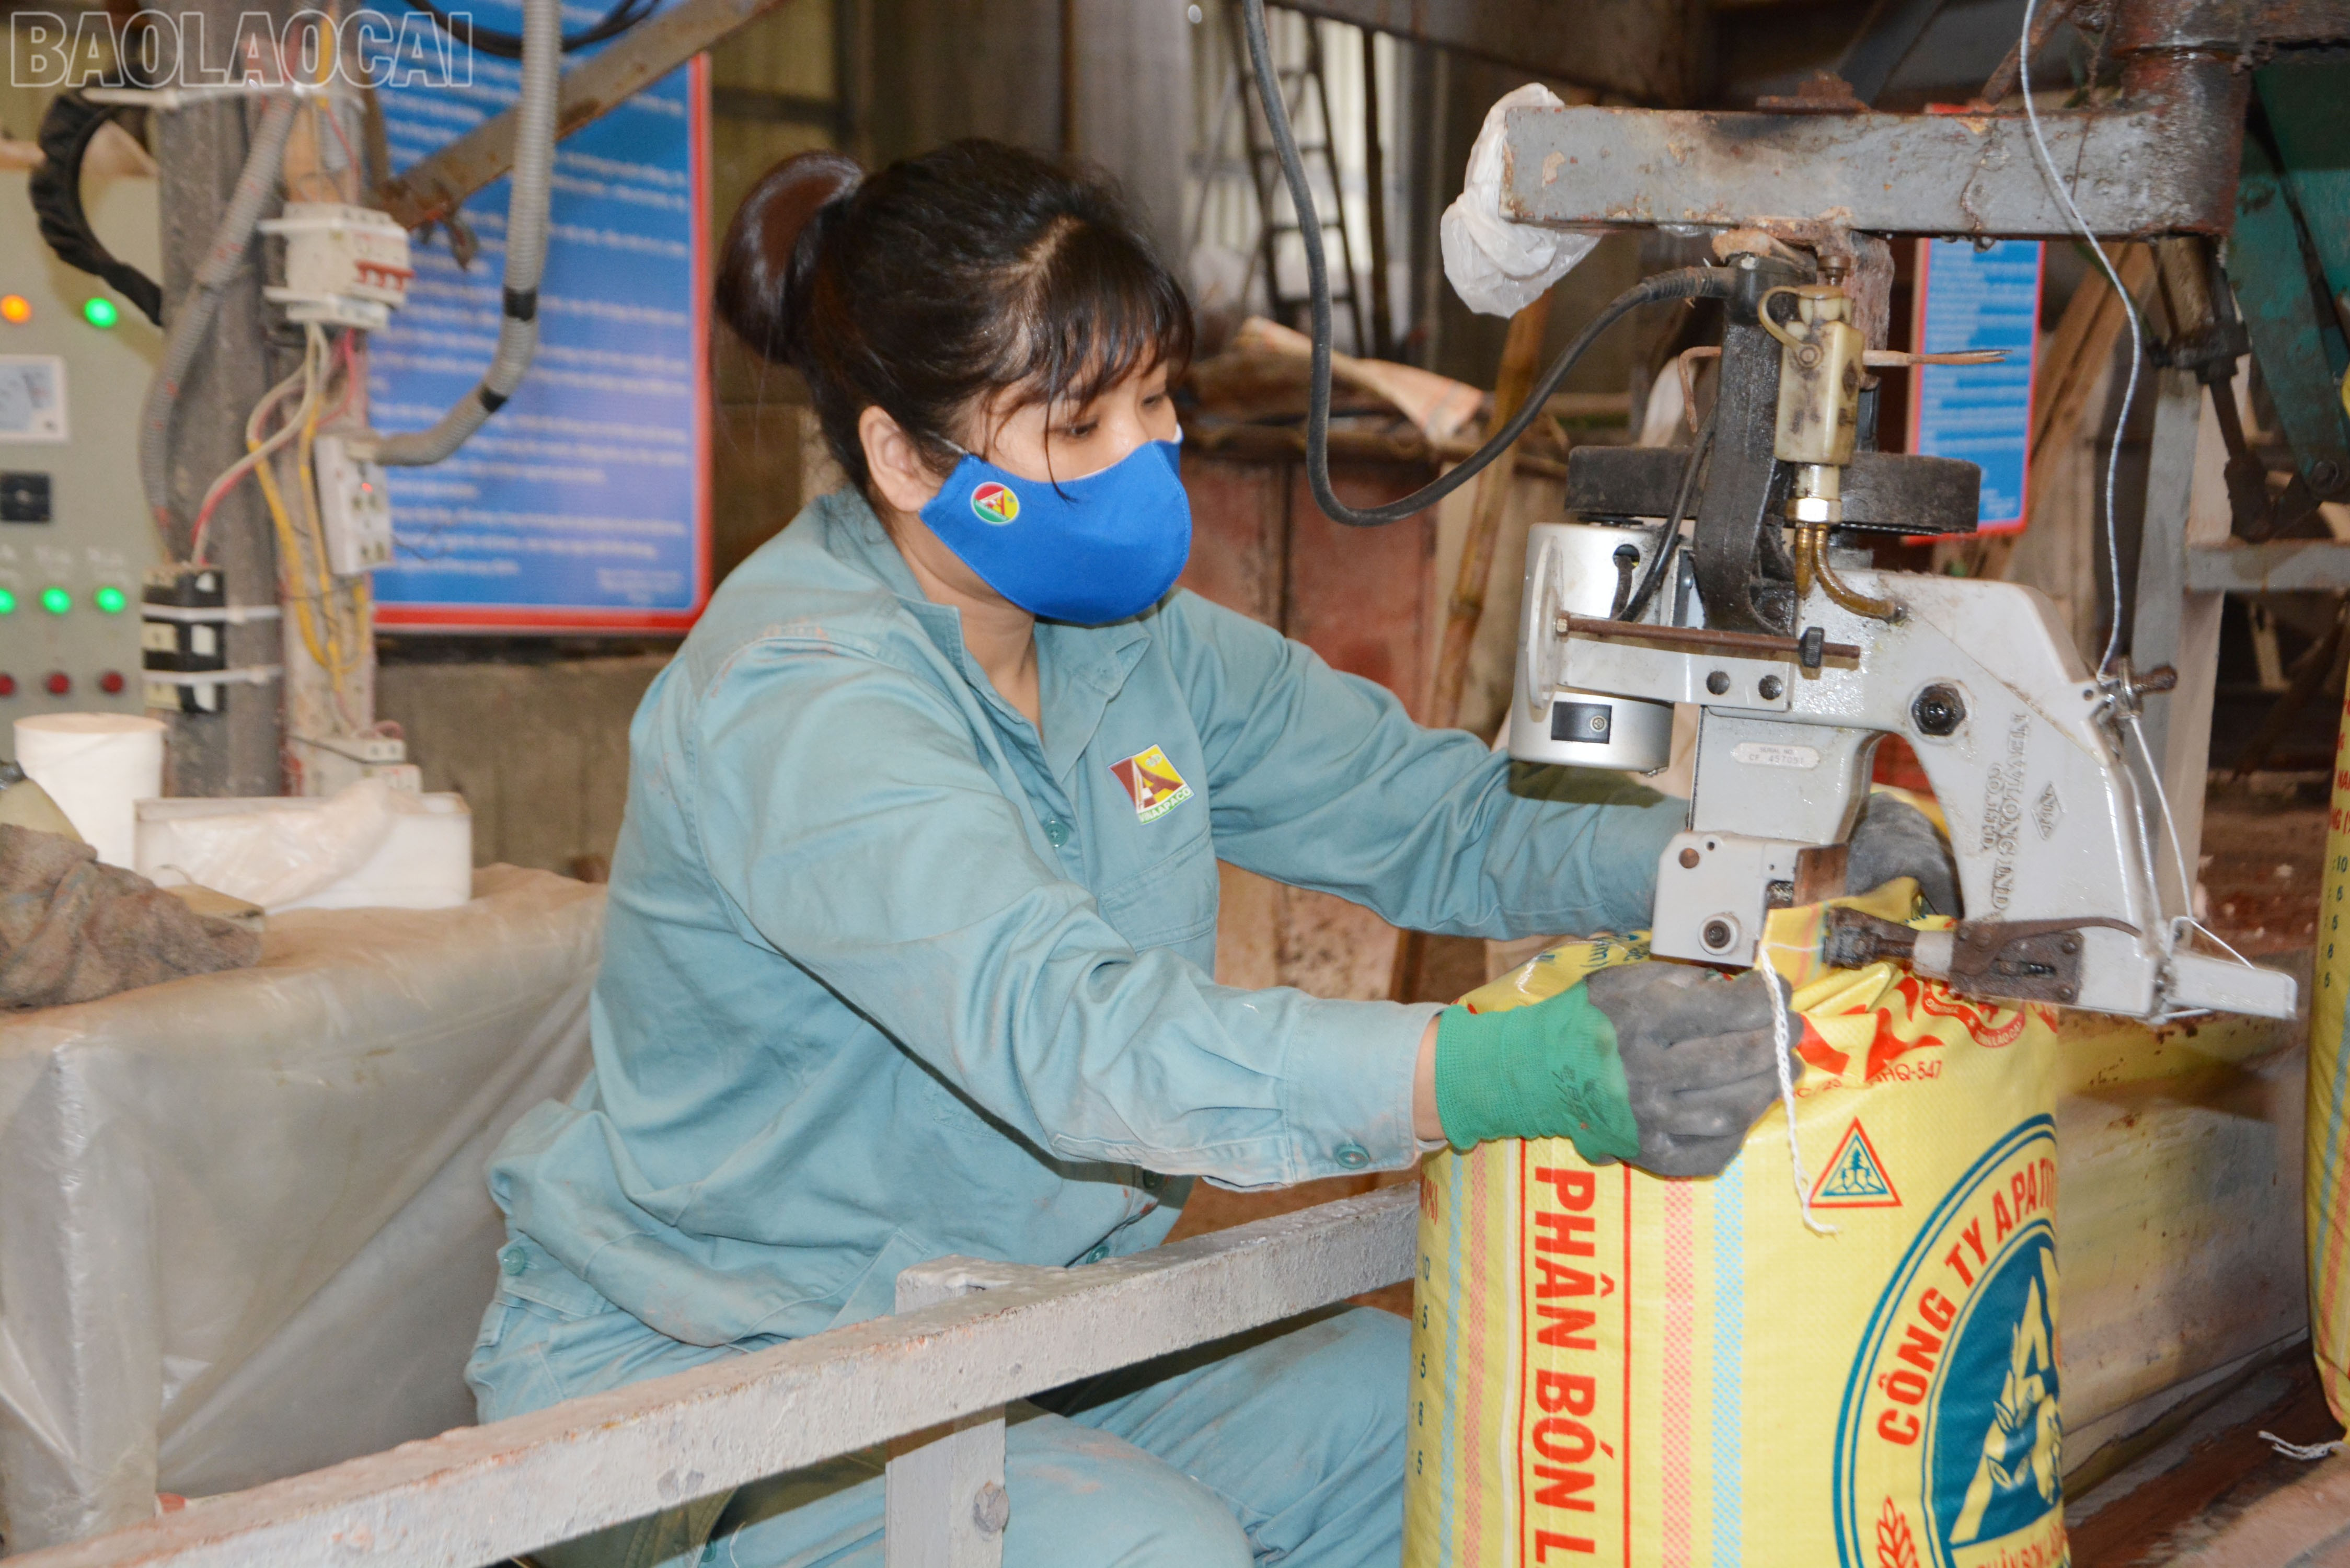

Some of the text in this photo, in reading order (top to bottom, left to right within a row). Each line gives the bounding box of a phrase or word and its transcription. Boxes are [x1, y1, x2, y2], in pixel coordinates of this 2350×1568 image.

[1534, 1166, 1615, 1351] PHÂN
[1877, 1286, 1957, 1446] CÔNG
[1943, 1215, 1988, 1288] TY
[1532, 1368, 1615, 1513] BÓN
[1535, 1528, 1596, 1568] L
